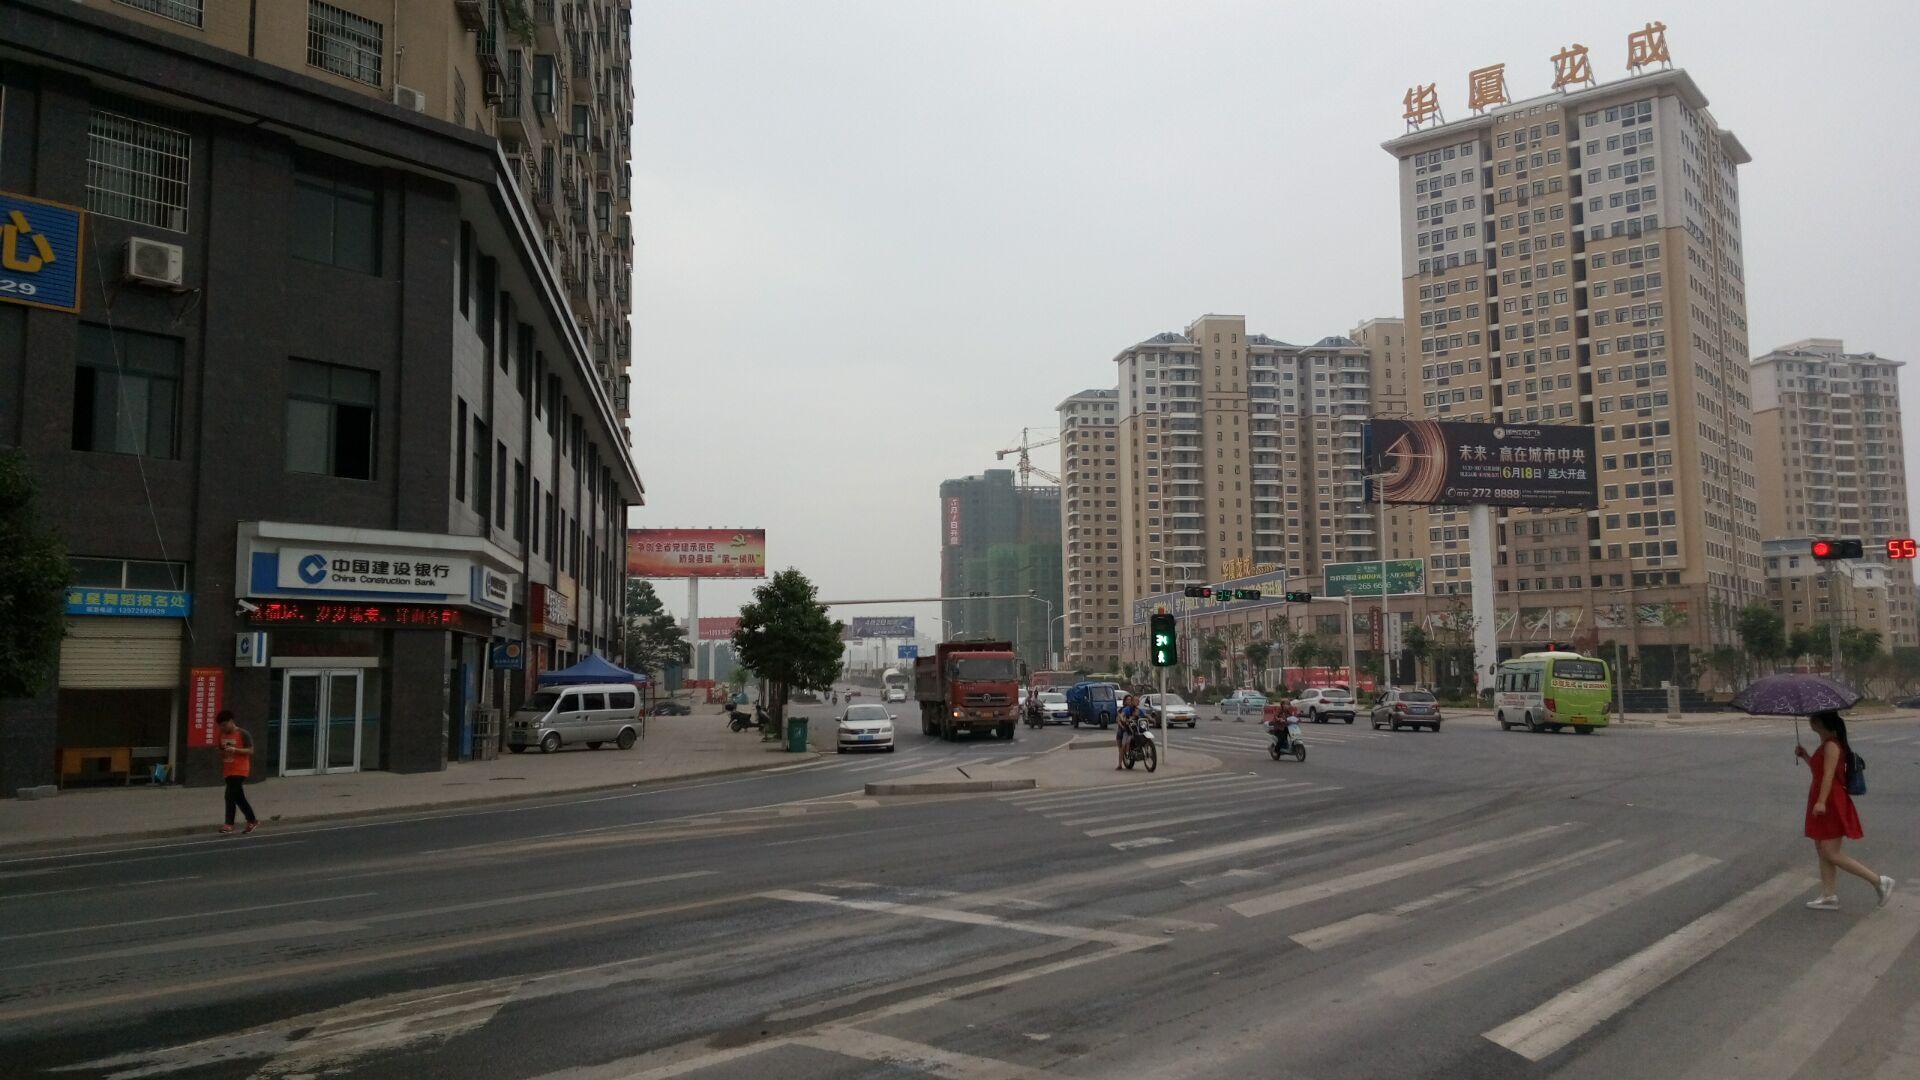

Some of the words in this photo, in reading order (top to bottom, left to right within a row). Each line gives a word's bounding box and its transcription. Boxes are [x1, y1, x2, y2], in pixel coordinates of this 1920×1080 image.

[1402, 21, 1668, 124] 华厦龙成
[1547, 469, 1587, 480] 盛大开盘
[1472, 487, 1491, 498] 272
[1494, 488, 1520, 499] 8888
[637, 542, 715, 553] 争创全省党建示范区
[1888, 540, 1915, 558] 55
[332, 558, 450, 578] 中国建设银行
[331, 575, 356, 583] China
[360, 575, 411, 585] Construction
[414, 578, 436, 586] Bank
[1217, 590, 1231, 601] 34
[1155, 634, 1168, 647] 34
